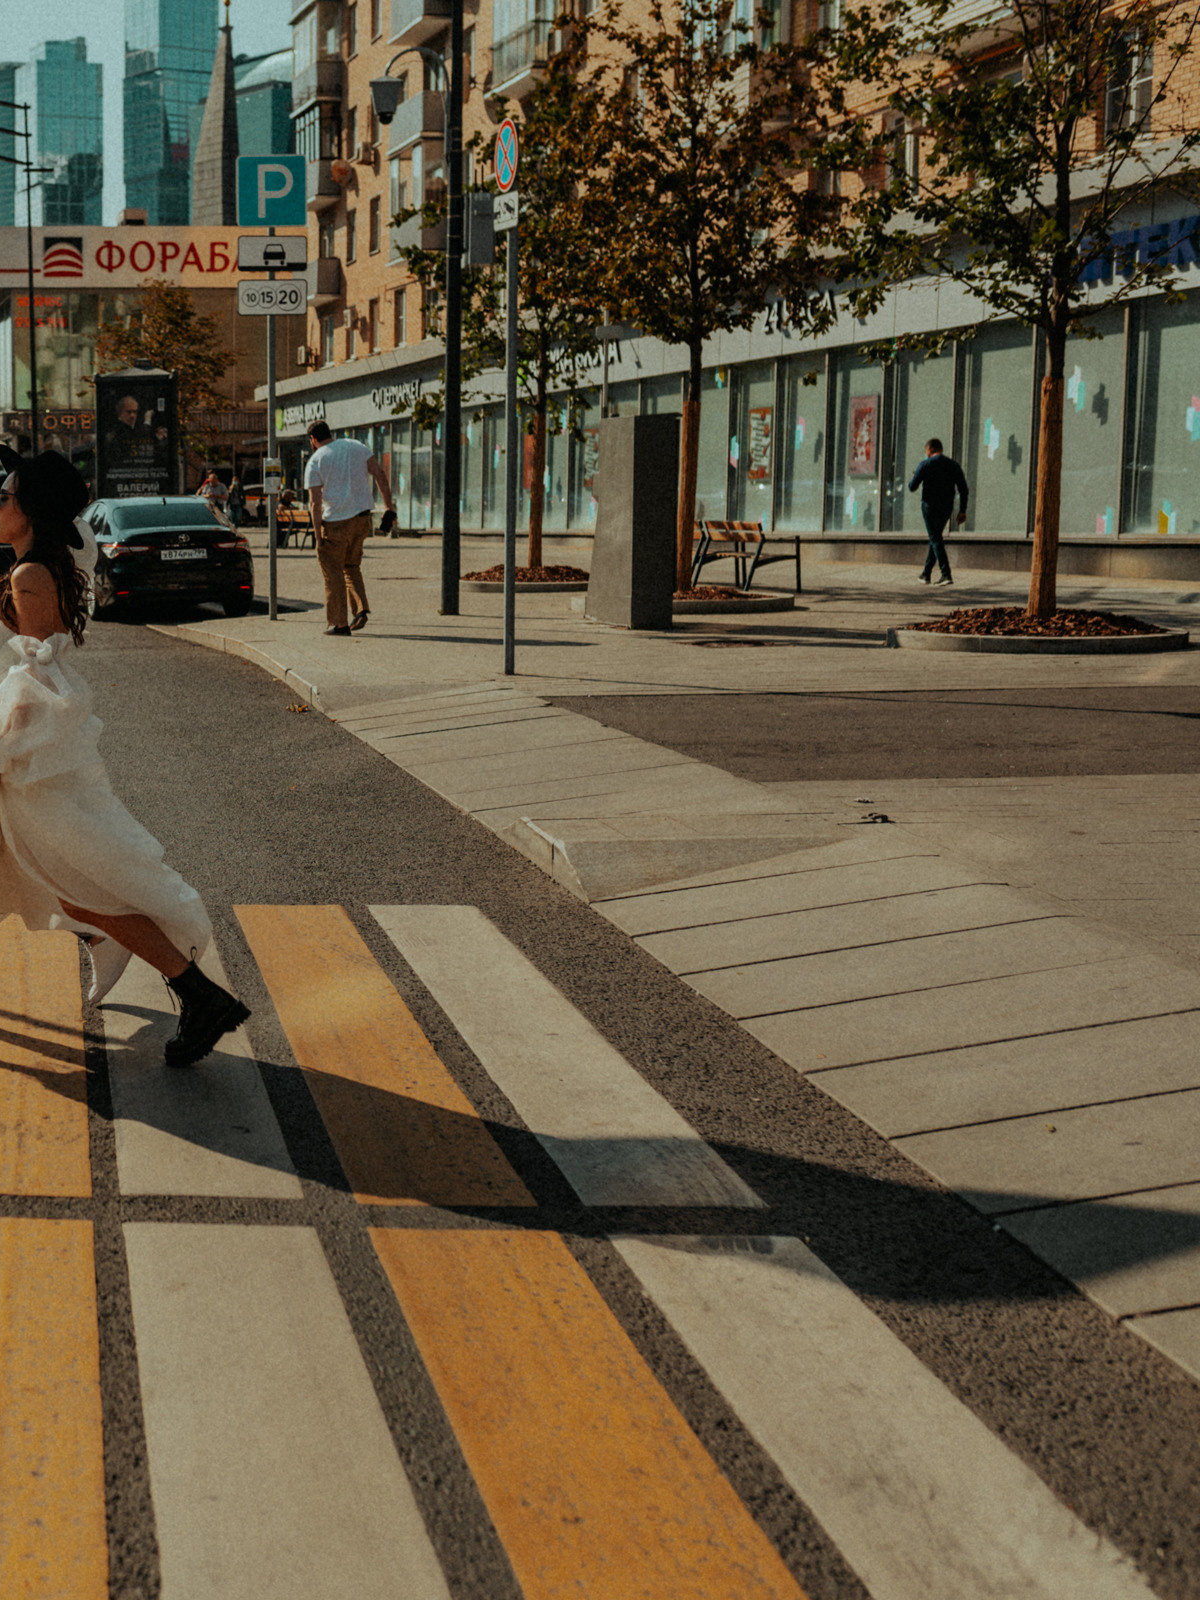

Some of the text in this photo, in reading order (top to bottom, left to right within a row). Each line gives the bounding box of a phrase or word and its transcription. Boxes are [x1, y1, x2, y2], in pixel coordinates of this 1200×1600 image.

[257, 163, 294, 219] P
[246, 289, 299, 305] 10 15 20
[117, 482, 160, 492] ВАЛЕРИЙ
